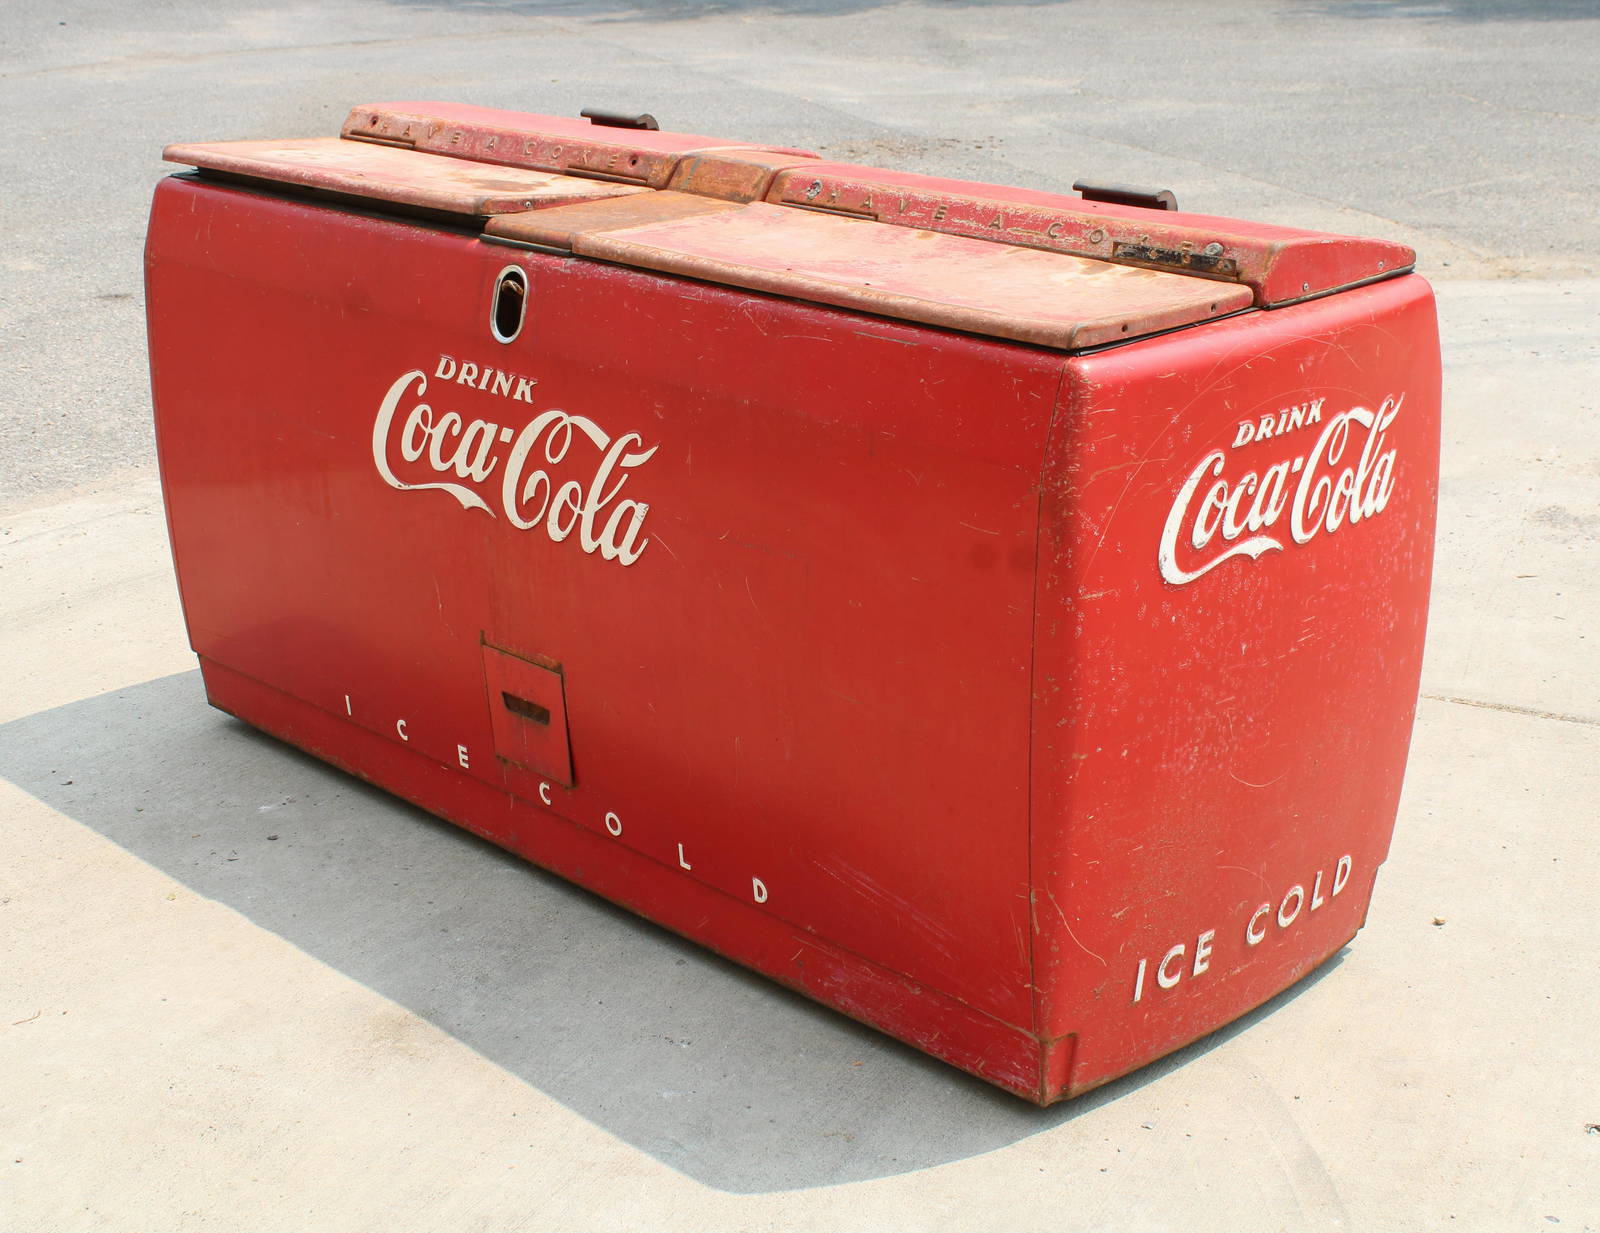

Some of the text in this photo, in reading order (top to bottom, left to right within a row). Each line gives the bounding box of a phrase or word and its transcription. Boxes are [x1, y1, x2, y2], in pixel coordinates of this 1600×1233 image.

[434, 355, 538, 404] DRINK
[1231, 397, 1326, 449] DRINK
[372, 370, 660, 566] Coca-Cola
[1158, 392, 1405, 585] Coca-Cola
[344, 694, 768, 904] ICE COLD
[1133, 855, 1353, 1003] ICE COLD
